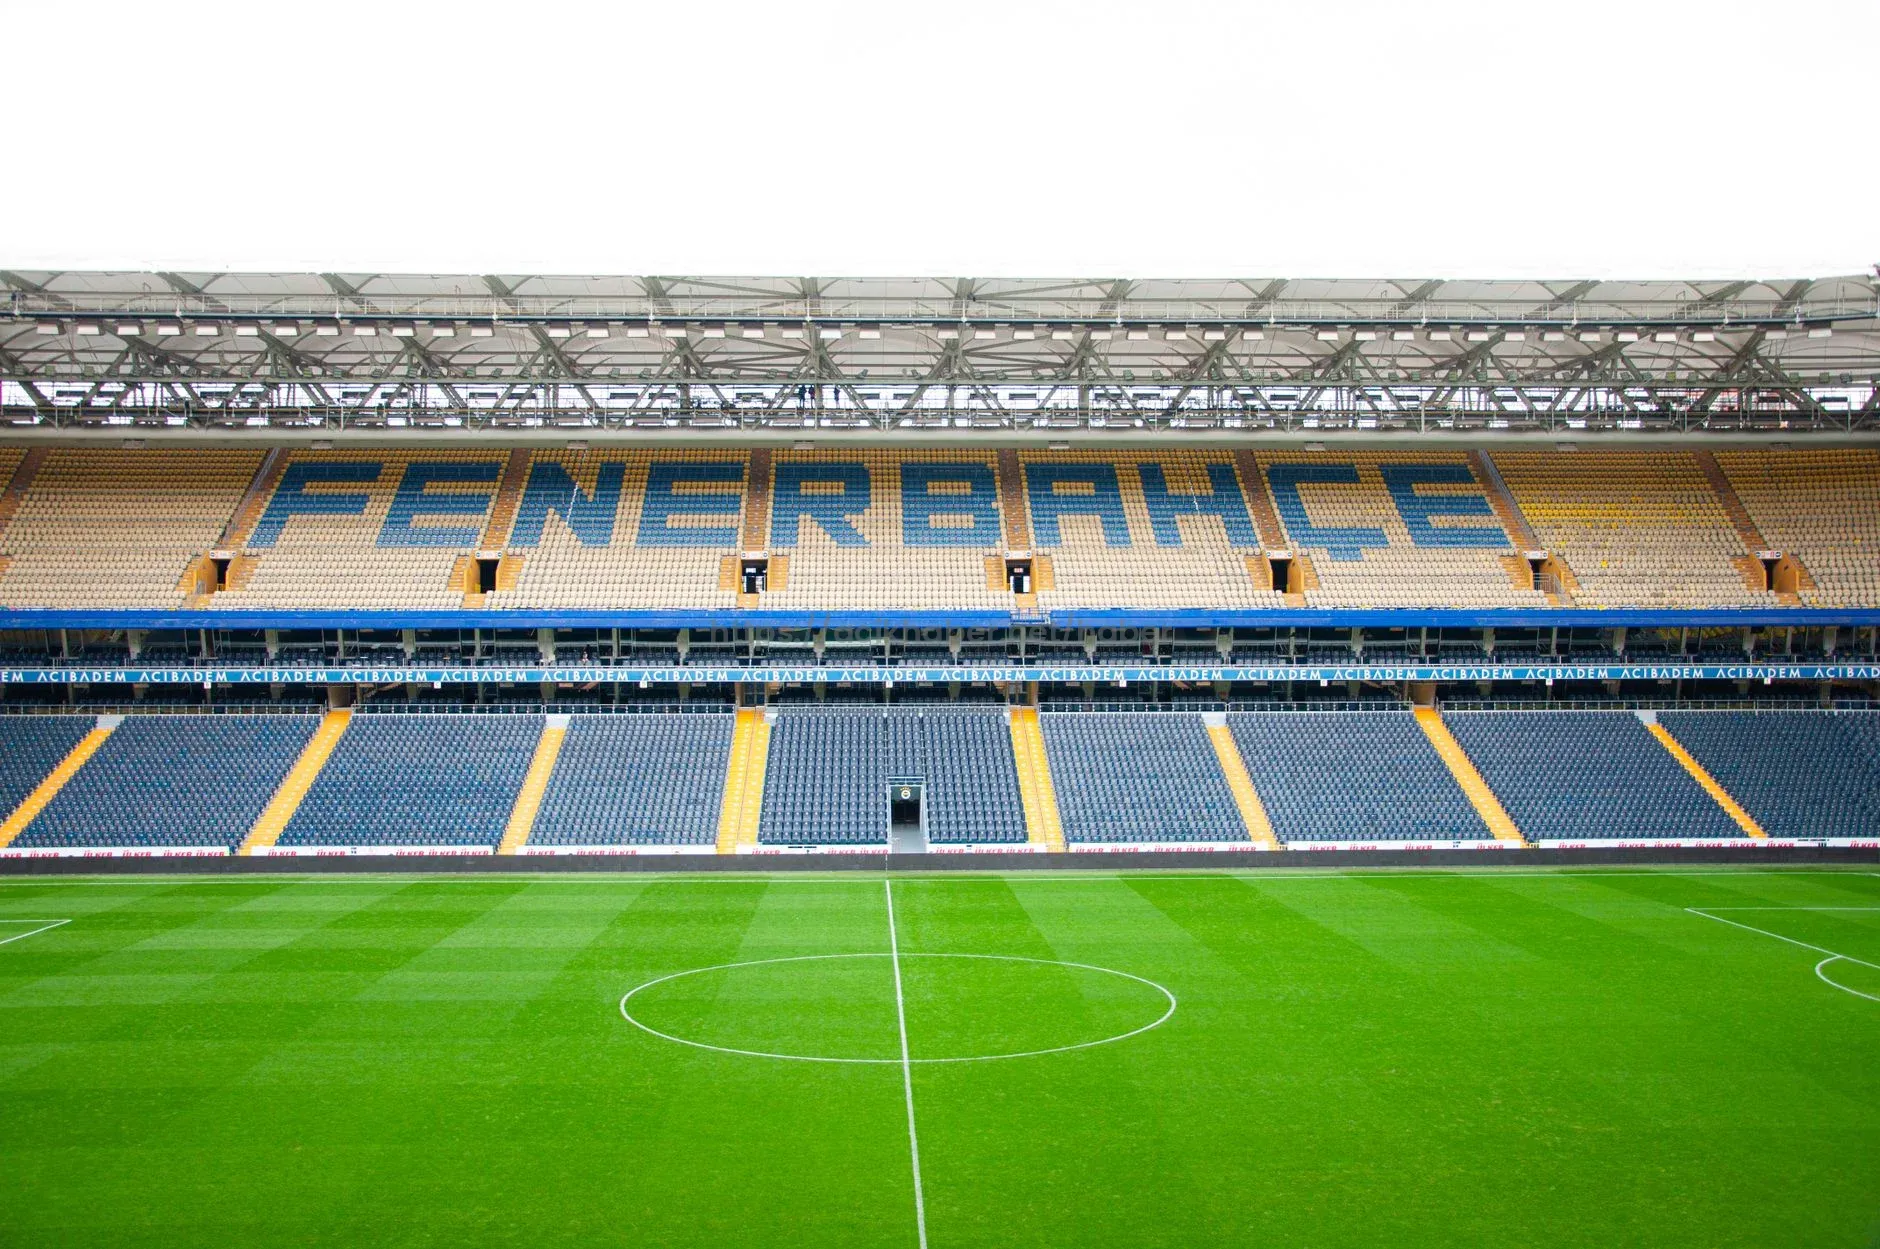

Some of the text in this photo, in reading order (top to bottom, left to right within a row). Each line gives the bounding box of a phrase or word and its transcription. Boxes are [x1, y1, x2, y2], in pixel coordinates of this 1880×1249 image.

[246, 461, 1512, 561] FENERBAHÇE
[37, 671, 126, 682] ACIBADEM
[139, 671, 227, 682] ACIBADEM
[240, 671, 327, 682] ACIBADEM
[340, 671, 427, 682] ACIBADEM
[440, 671, 527, 681] ACIBADEM
[540, 671, 628, 681] ACIBADEM
[640, 671, 728, 681] ACIBADEM
[740, 671, 828, 681] ACIBADEM
[840, 671, 928, 681] ACIBADEM
[940, 670, 1027, 680] ACIBADEM
[1038, 670, 1125, 680] ACIBADEM
[1136, 670, 1223, 680] ACIBADEM
[1235, 669, 1321, 679] ACIBADEM
[1332, 669, 1418, 679] ACIBADEM
[1429, 669, 1514, 679] ACIBADEM
[1525, 669, 1609, 679] ACIBADEM
[1619, 668, 1704, 678] ACIBADEM
[1715, 668, 1801, 678] ACIBADEM
